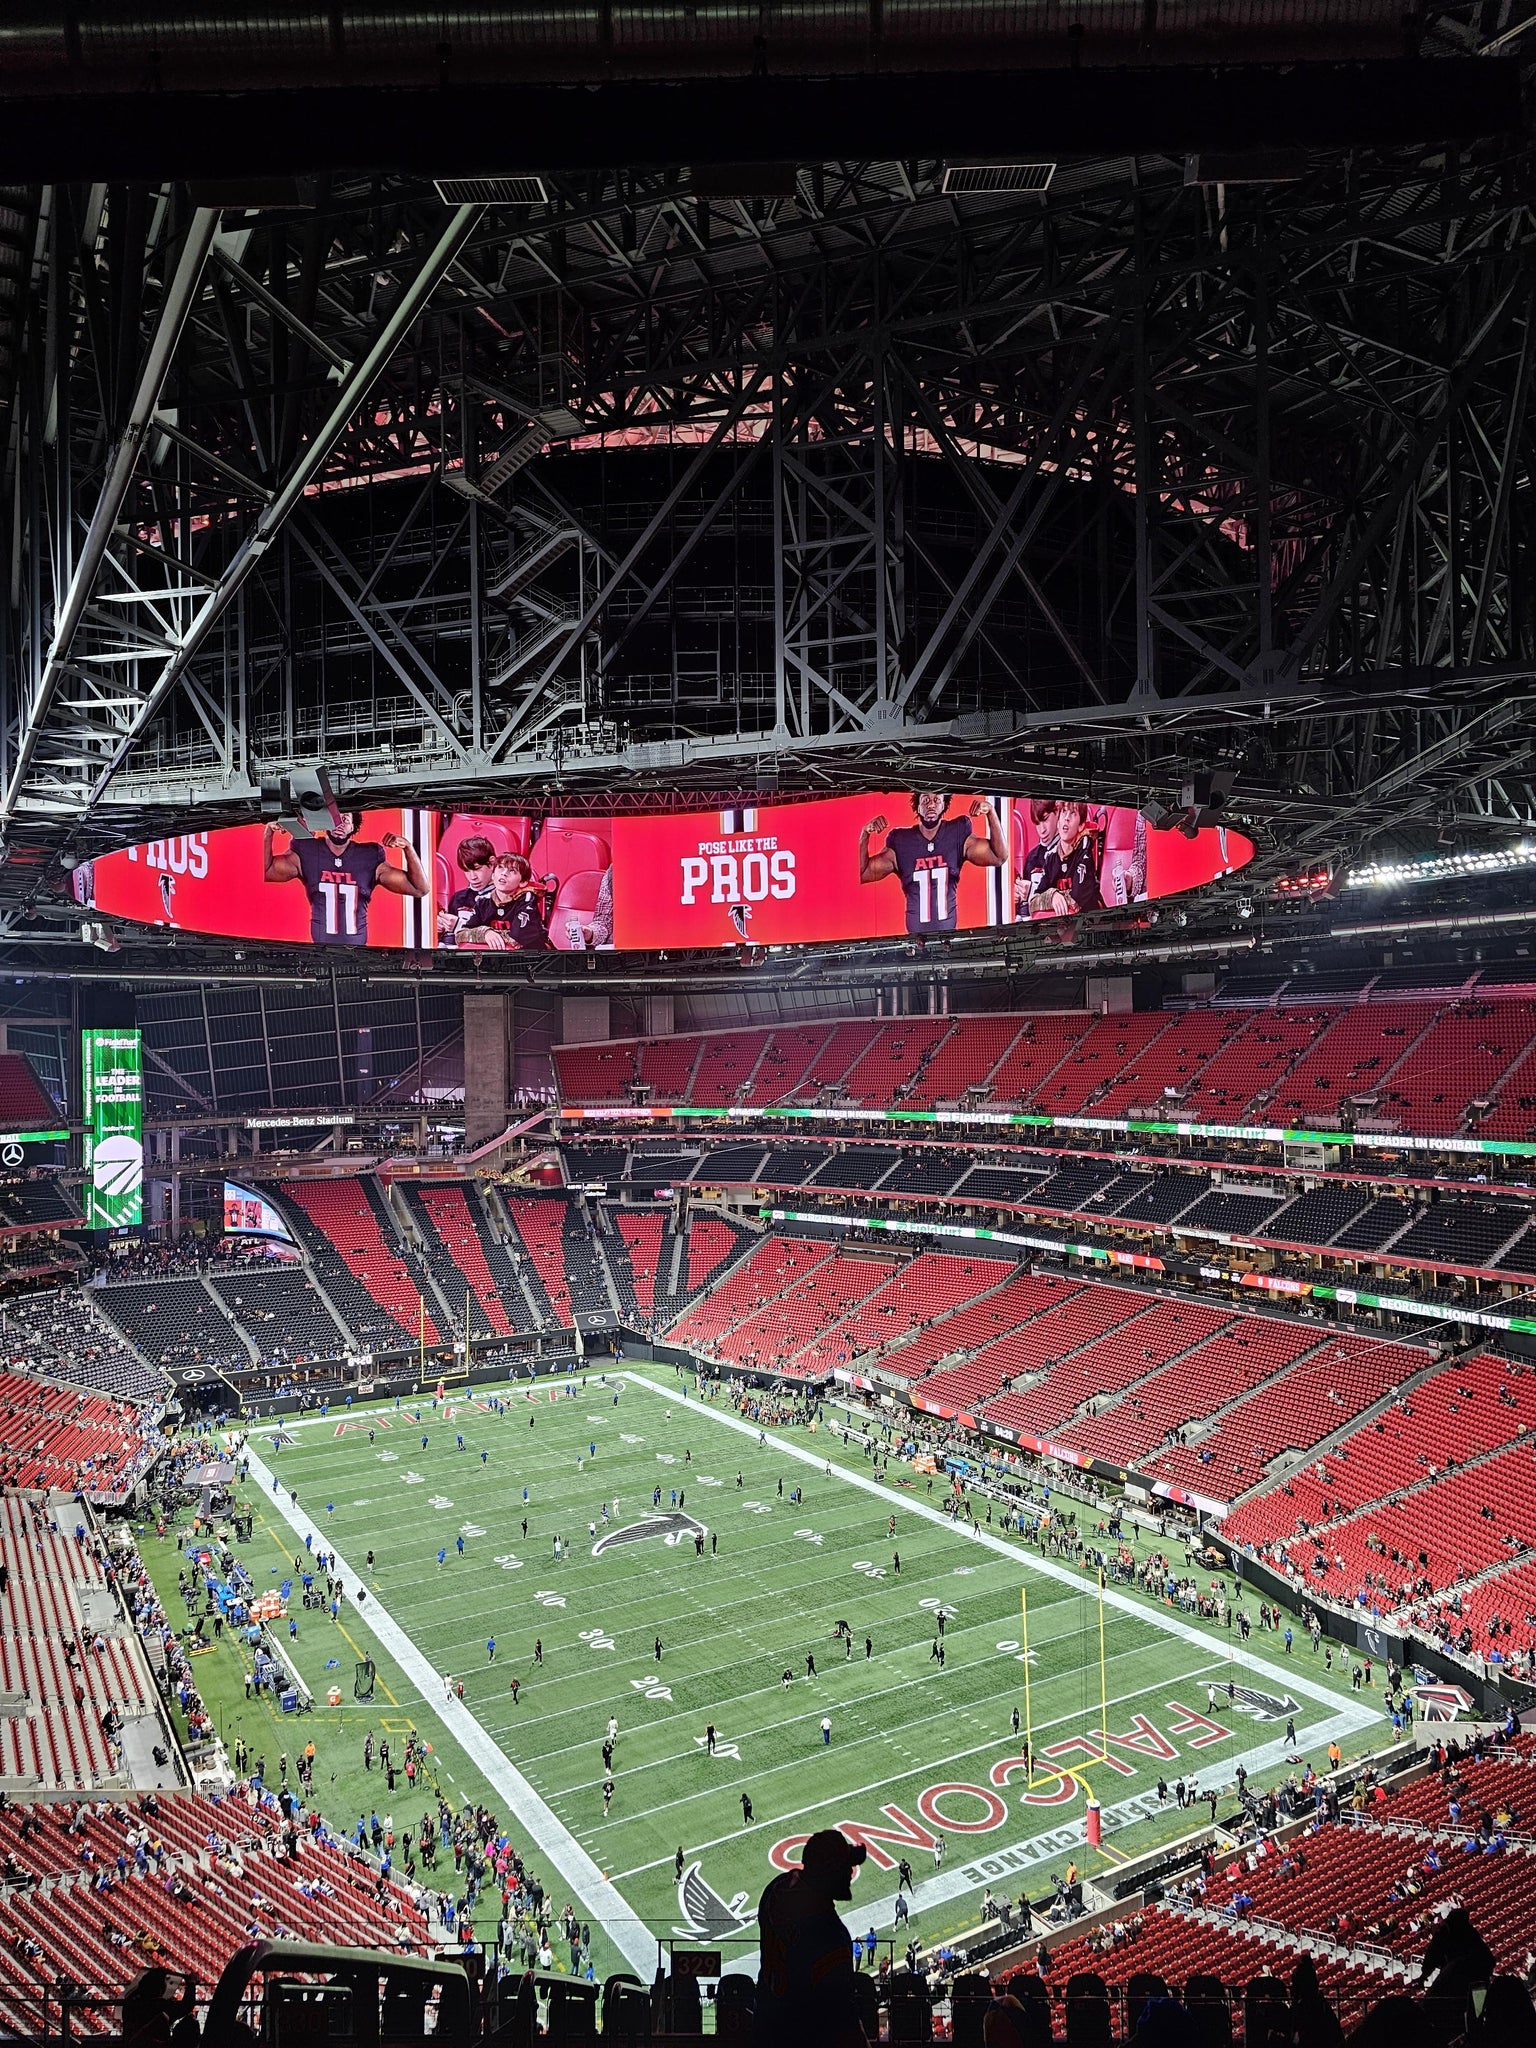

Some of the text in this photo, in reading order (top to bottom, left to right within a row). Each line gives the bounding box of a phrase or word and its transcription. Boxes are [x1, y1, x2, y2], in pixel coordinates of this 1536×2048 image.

[698, 837, 777, 855] POSE LIKE THE
[914, 855, 948, 871] ATL
[320, 870, 357, 884] ATL
[680, 850, 796, 905] PROS
[913, 867, 949, 923] 11
[319, 882, 358, 935] 11
[95, 1075, 141, 1087] LEADER
[95, 1093, 141, 1103] FOOTBALL
[246, 1115, 354, 1128] Mercedes-Benz Stadium
[1204, 1126, 1267, 1139] FieldTurf
[1354, 1134, 1481, 1152] THE LEADER IN FOOTBALL
[1379, 1297, 1511, 1330] GEORGIA'S HOME TURF
[333, 1389, 586, 1437] ATLANTA
[428, 1494, 456, 1509] 30
[742, 1501, 773, 1514] 50
[459, 1521, 488, 1538] 40
[793, 1528, 826, 1546] 40
[493, 1553, 525, 1570] 50
[851, 1560, 887, 1579] 30
[533, 1590, 567, 1607] 40
[578, 1628, 616, 1650] 30
[630, 1675, 672, 1699] 20
[961, 1829, 1081, 1885] CHANGE
[678, 1956, 717, 1976] 329
